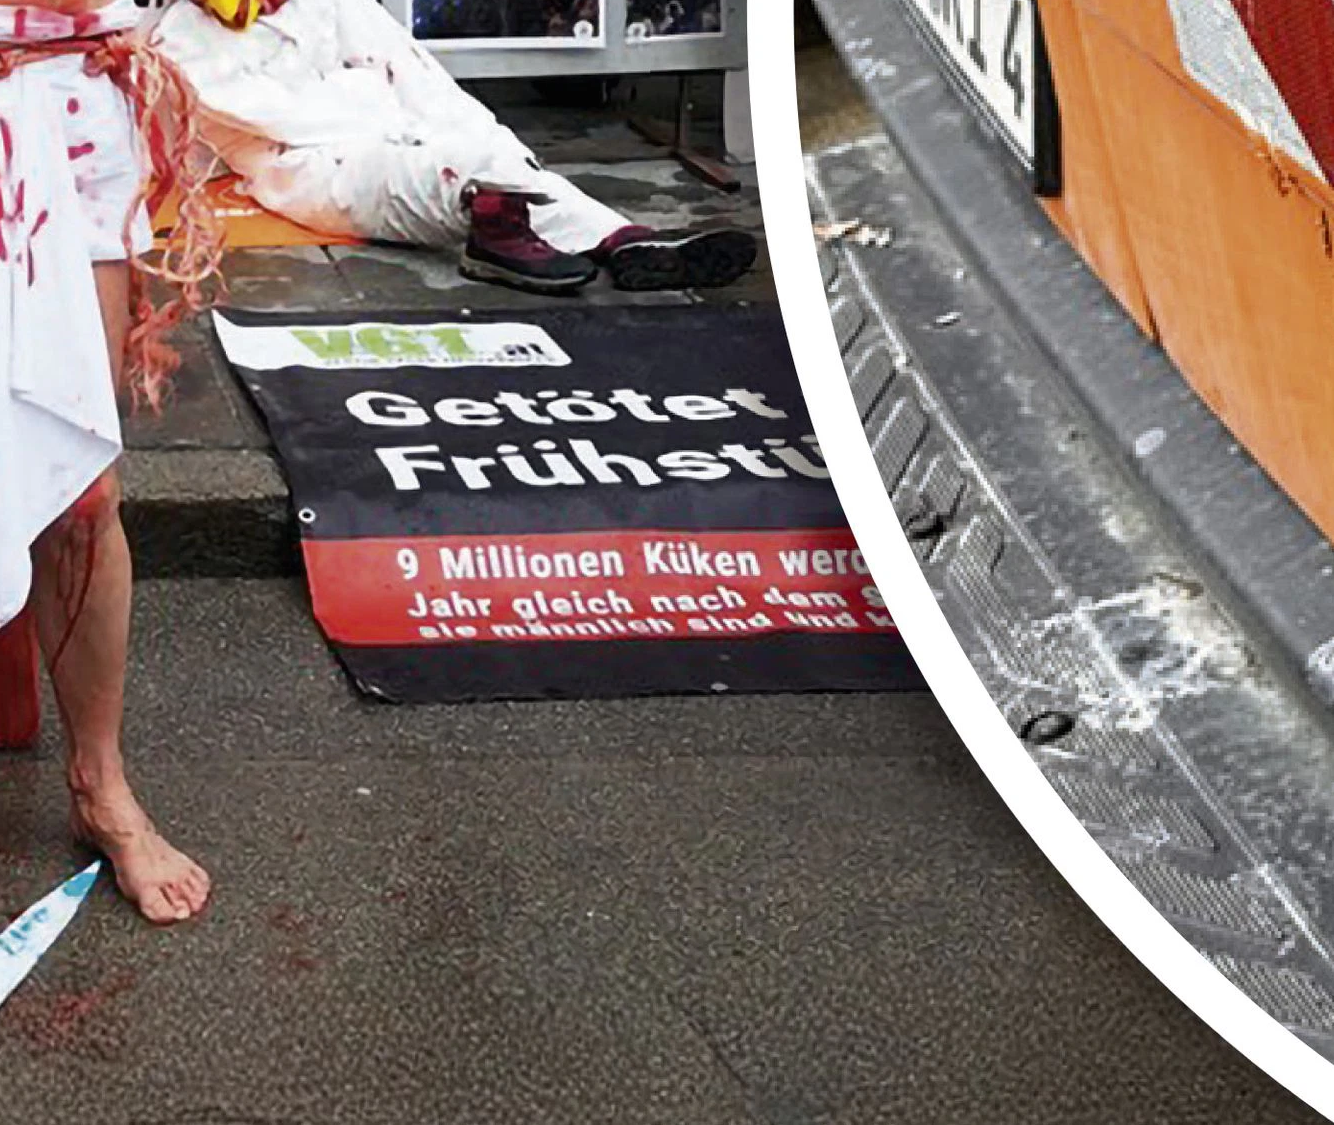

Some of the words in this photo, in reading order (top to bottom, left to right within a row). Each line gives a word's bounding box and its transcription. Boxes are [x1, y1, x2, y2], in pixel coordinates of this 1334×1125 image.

[345, 387, 787, 427] Getötet
[397, 549, 419, 579] 9
[439, 544, 626, 579] Millionen
[643, 542, 761, 576] Küken
[408, 591, 492, 619] Jahr
[512, 589, 634, 623] gleich
[651, 585, 746, 613] nach
[763, 586, 843, 609] dem
